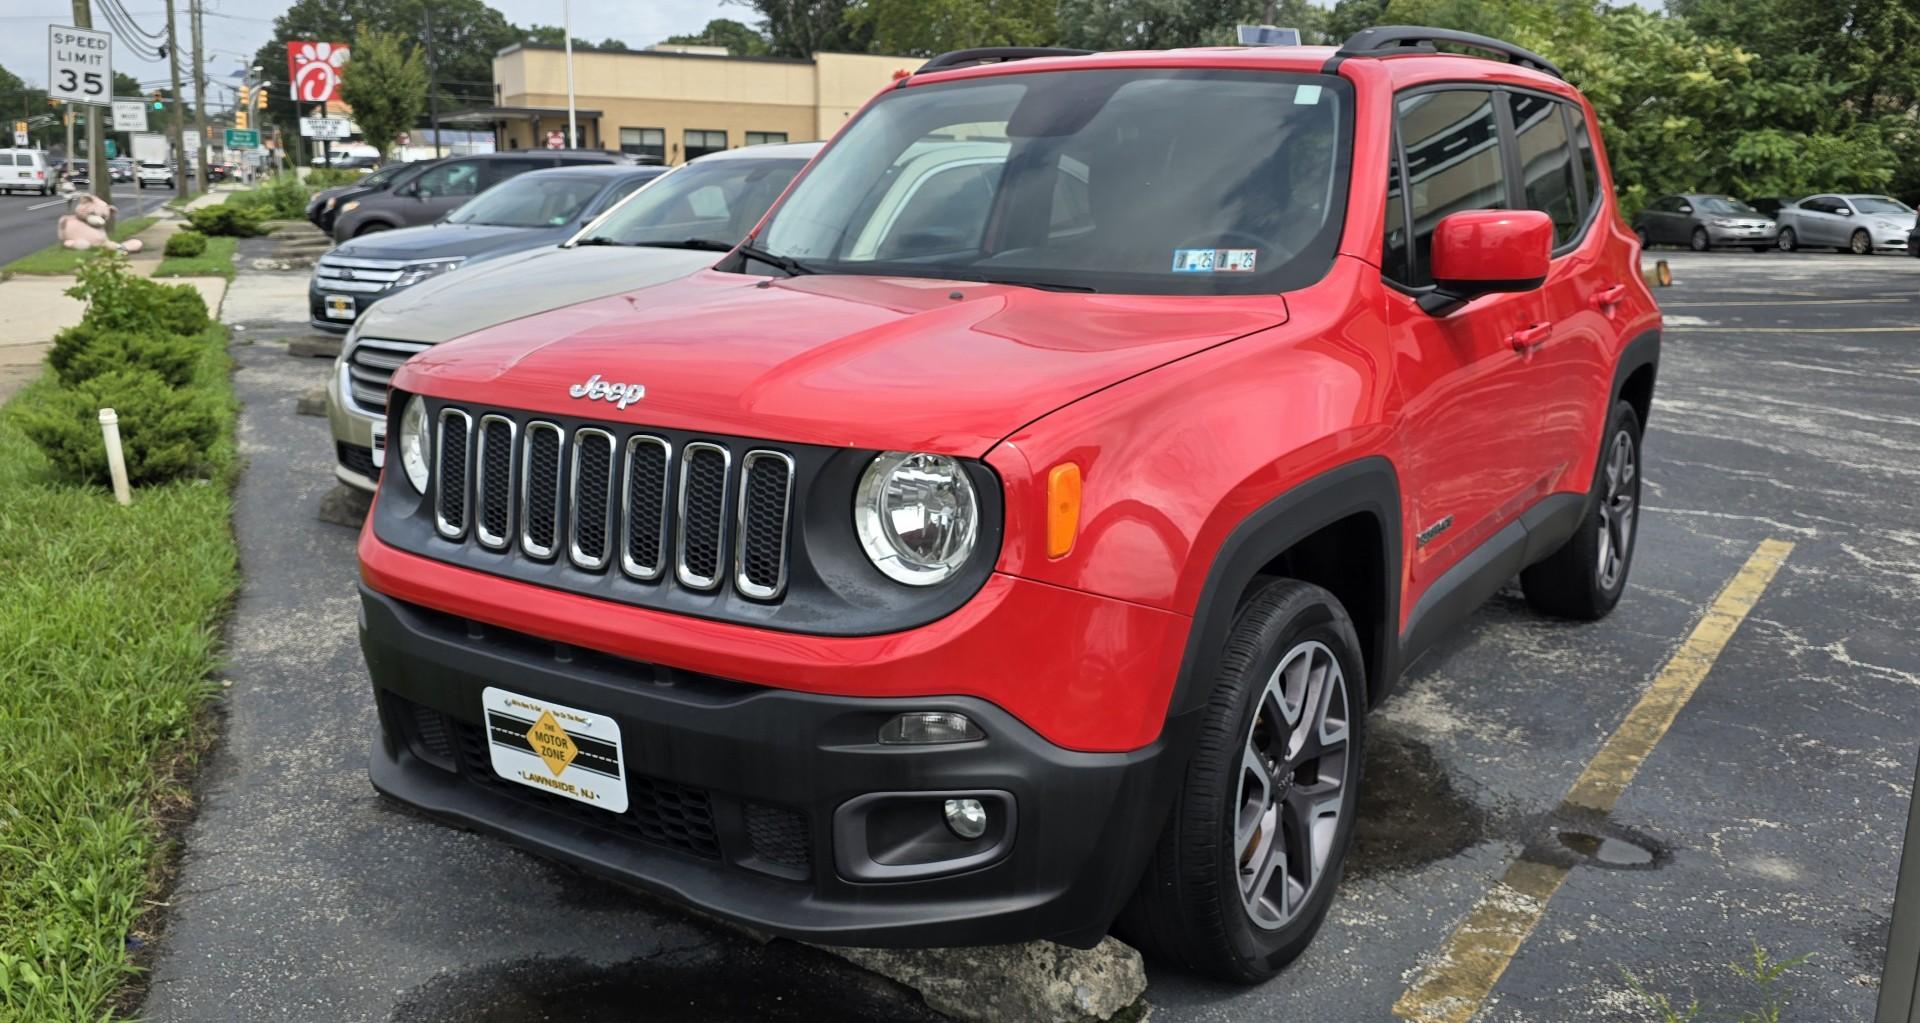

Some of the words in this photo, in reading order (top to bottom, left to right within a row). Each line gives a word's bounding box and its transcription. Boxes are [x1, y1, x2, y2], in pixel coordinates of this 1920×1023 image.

[54, 33, 107, 50] SPEED
[57, 50, 103, 65] LIMIT
[58, 69, 103, 95] 35
[569, 374, 646, 410] Jeep
[544, 723, 555, 732] THE
[535, 731, 568, 750] MOTOR
[541, 745, 565, 761] ZONE
[522, 770, 579, 796] LAWNSIDE,
[581, 787, 594, 799] NJ
